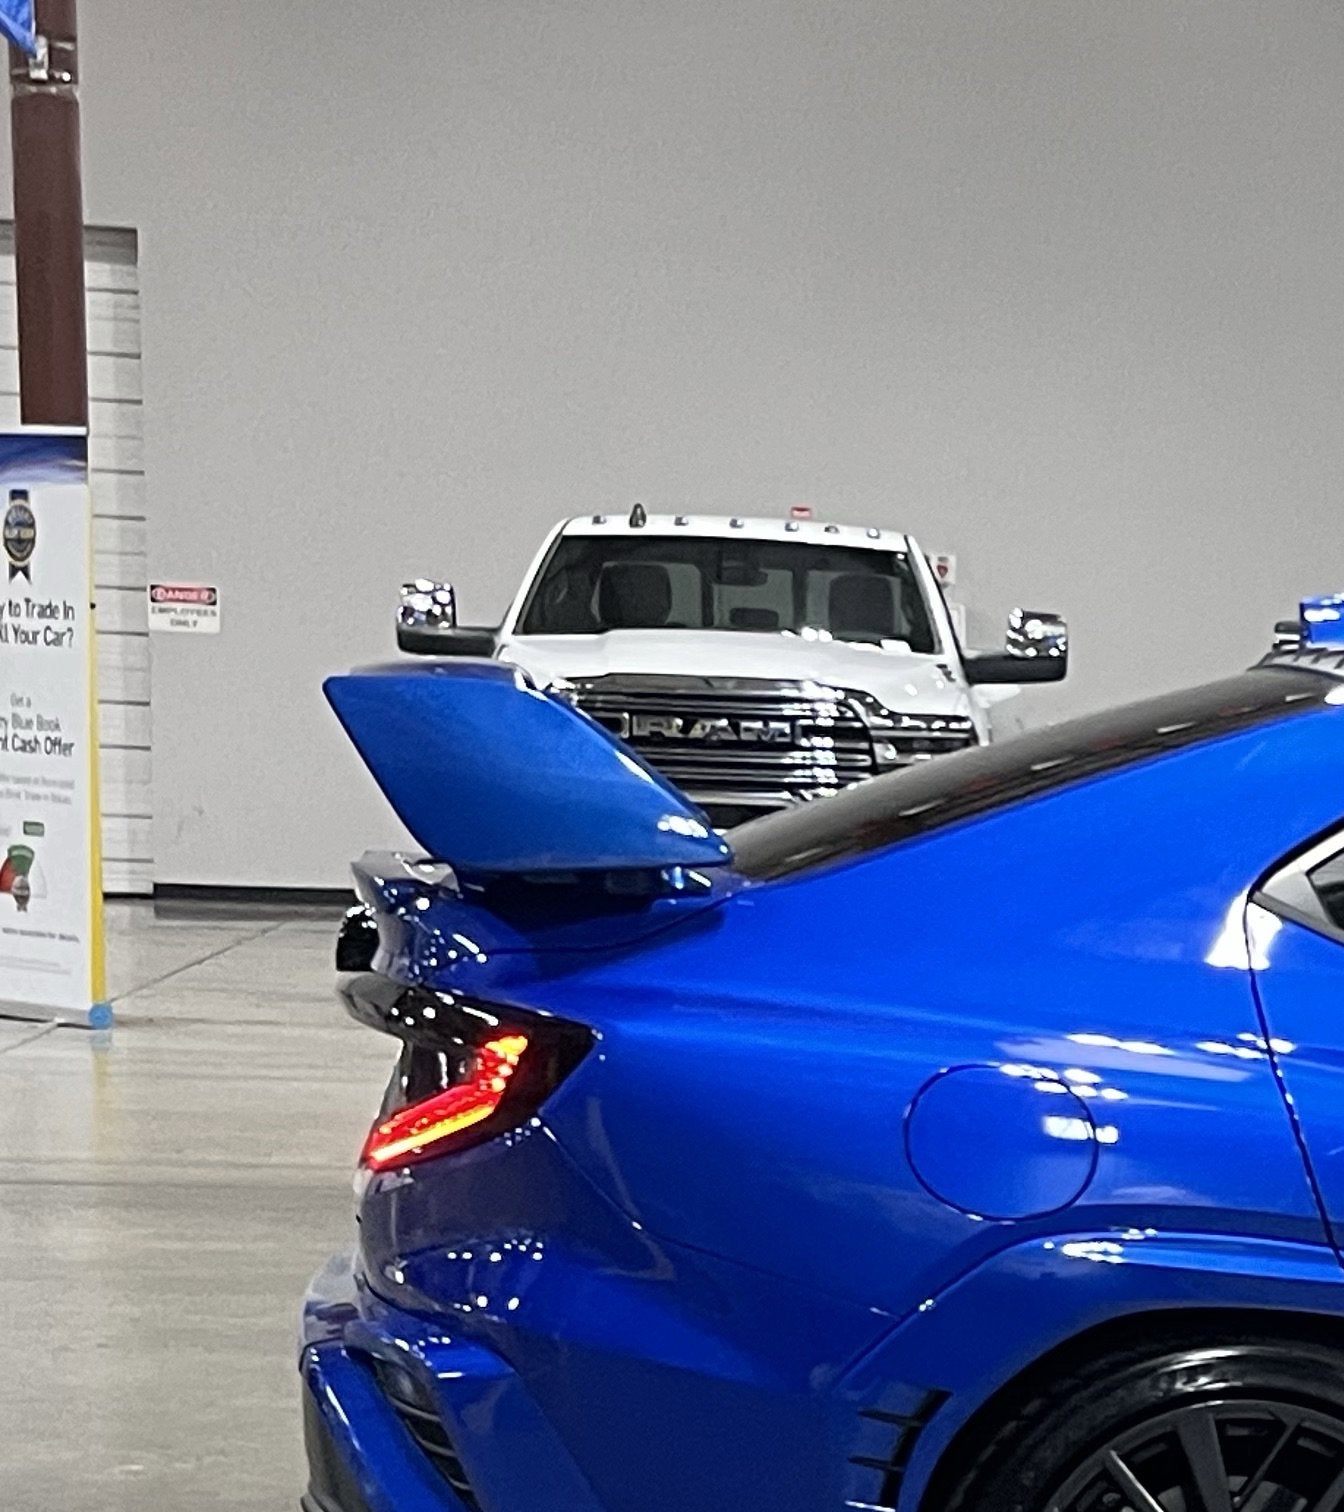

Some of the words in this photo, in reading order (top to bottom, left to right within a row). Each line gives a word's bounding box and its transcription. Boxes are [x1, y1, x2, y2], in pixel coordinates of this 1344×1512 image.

[8, 599, 21, 618] to
[24, 597, 60, 620] Trade
[63, 599, 75, 621] In
[12, 623, 40, 645] Your
[44, 625, 74, 648] Car?
[632, 715, 791, 742] RAM
[12, 733, 41, 754] Cash
[44, 736, 75, 757] Offer
